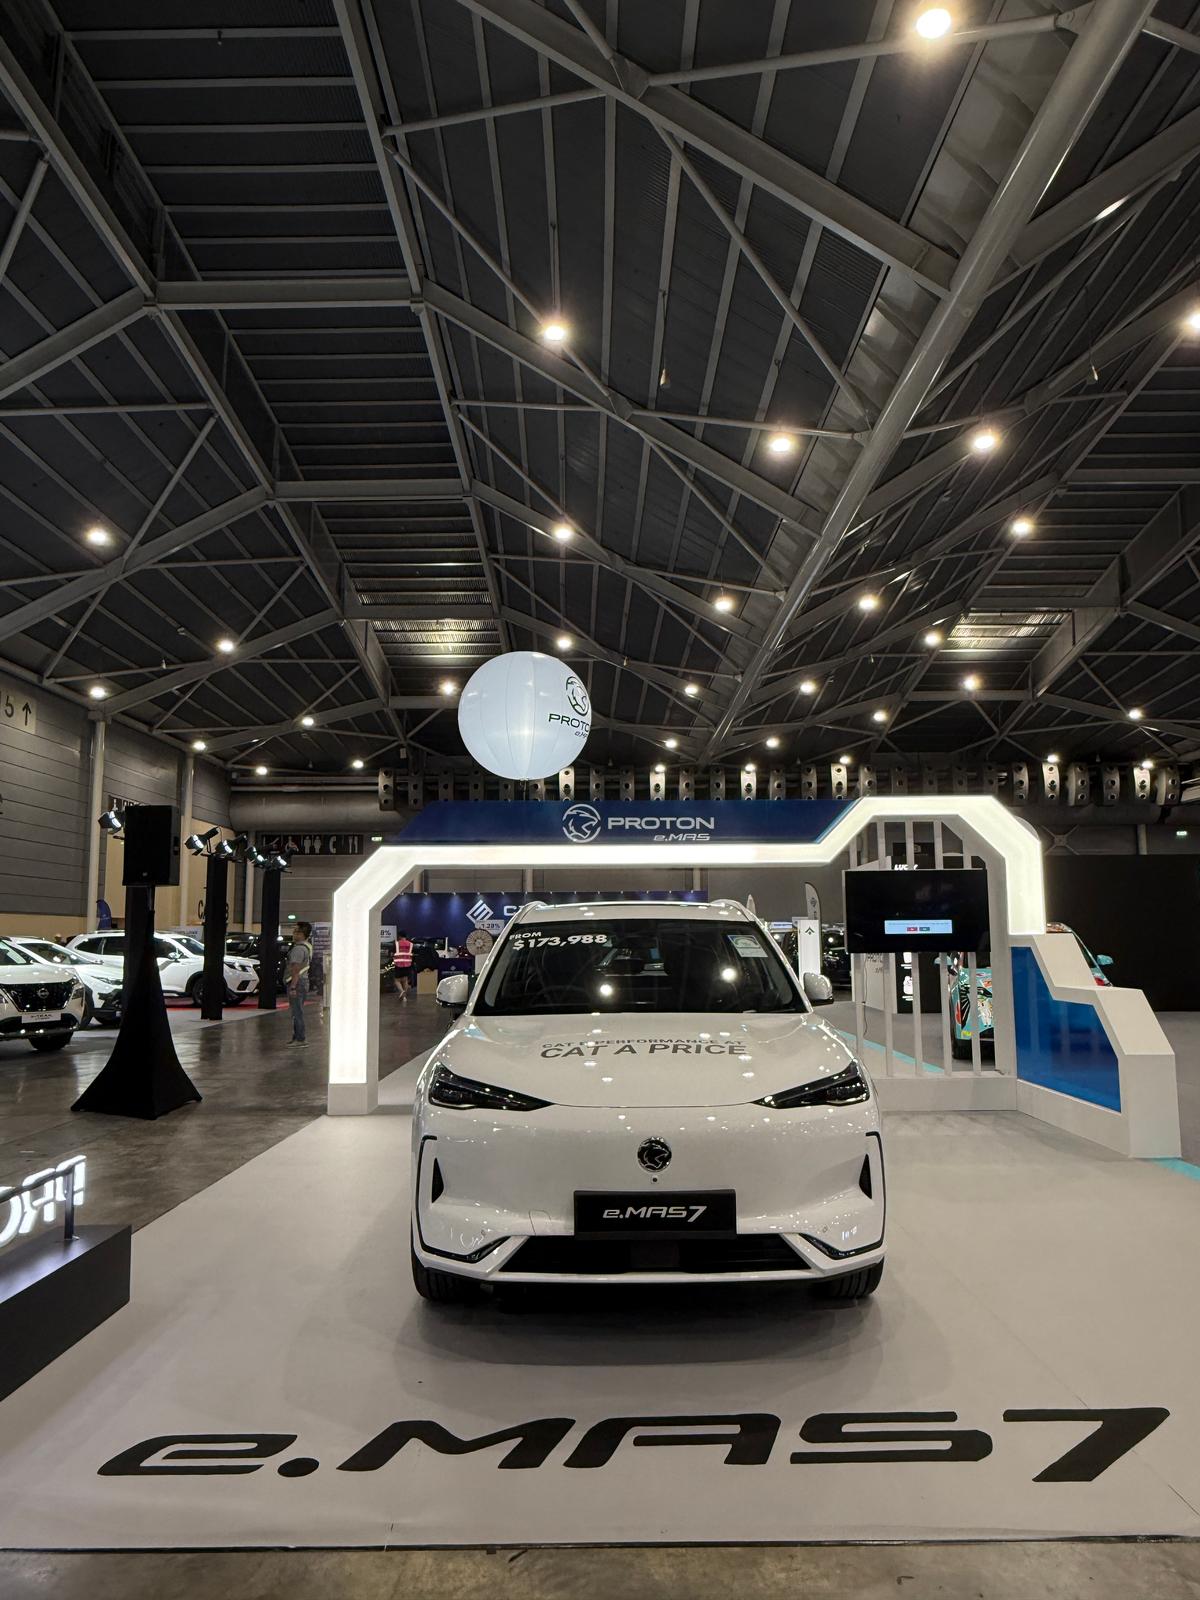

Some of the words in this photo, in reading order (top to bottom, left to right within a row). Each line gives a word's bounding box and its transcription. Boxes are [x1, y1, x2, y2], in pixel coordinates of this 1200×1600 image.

[608, 817, 715, 830] PROTON
[653, 833, 711, 841] e.MAS
[509, 932, 542, 940] FROM
[512, 934, 608, 951] $173,988
[540, 1045, 608, 1058] CAT
[613, 1044, 637, 1055] A
[648, 1043, 747, 1055] PRICE
